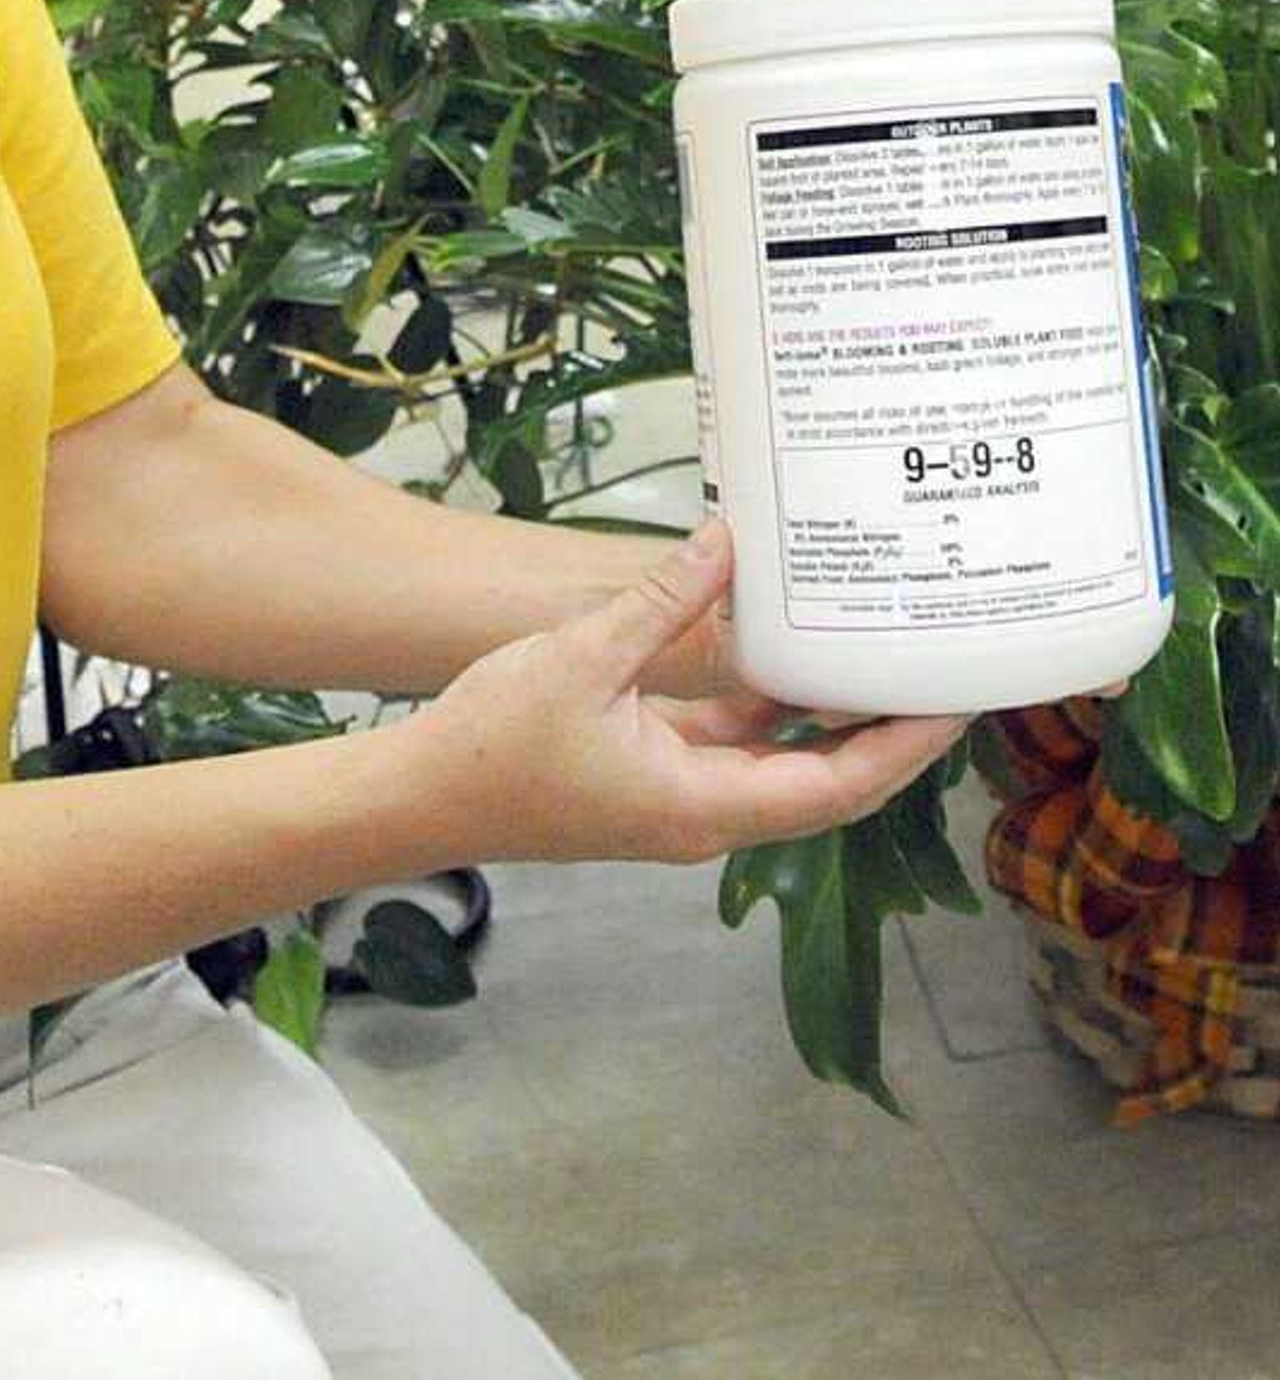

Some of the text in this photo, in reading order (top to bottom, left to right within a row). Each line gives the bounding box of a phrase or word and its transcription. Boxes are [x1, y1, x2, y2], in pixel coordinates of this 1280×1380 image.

[949, 118, 993, 135] PLANTS
[894, 229, 1008, 251] ROOTING SOLUTION
[832, 342, 895, 361] BLOOMING
[971, 332, 1021, 350] SOLUBLE
[1023, 329, 1057, 345] PLANT
